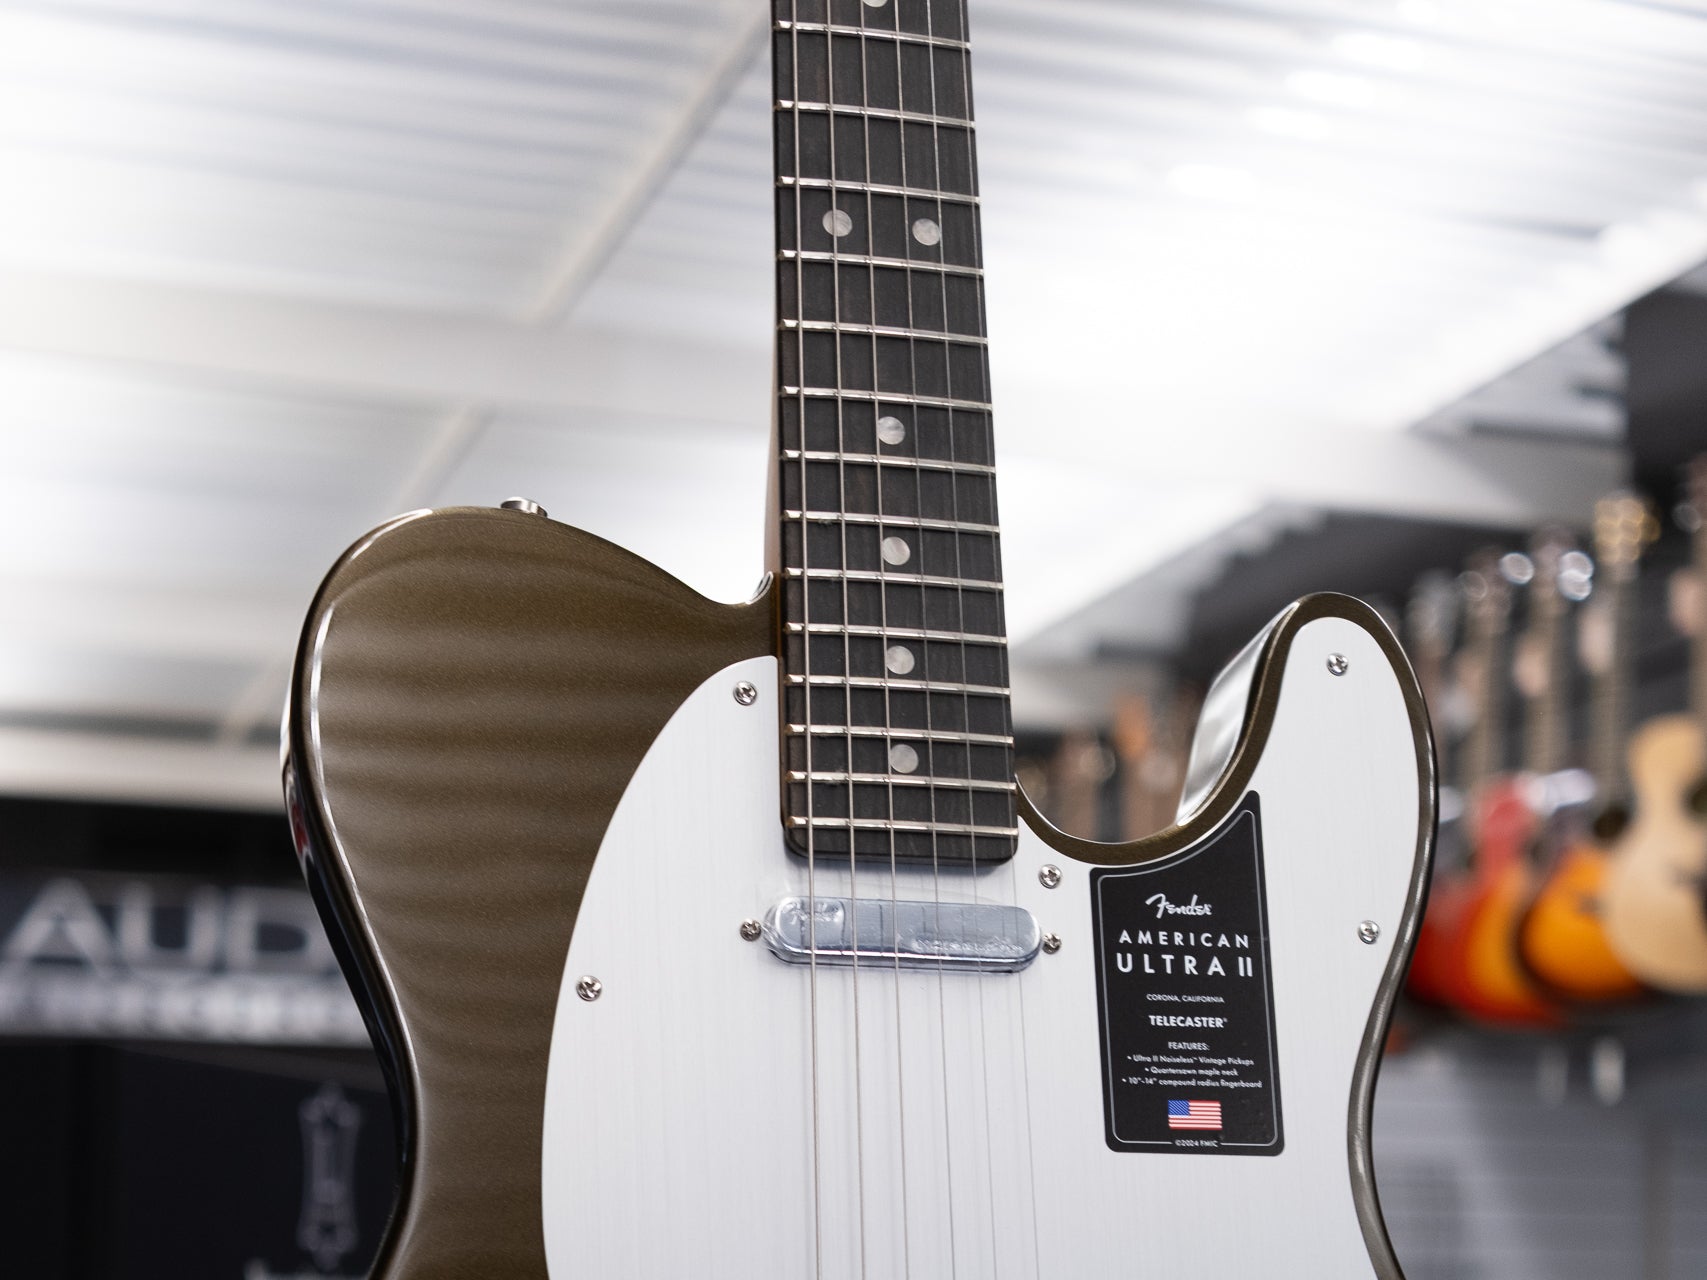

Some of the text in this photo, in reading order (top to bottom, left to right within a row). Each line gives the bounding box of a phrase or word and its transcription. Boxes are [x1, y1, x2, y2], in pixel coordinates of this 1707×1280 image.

[3, 878, 345, 972] AUD
[1119, 929, 1249, 948] AMERICAN
[1116, 952, 1253, 977] ULTRA II
[1146, 994, 1225, 1003] CORONA, CALIFORNIA
[1168, 1041, 1210, 1050] FEATURES:
[1132, 1055, 1152, 1063] Ultra
[1198, 1057, 1226, 1066] Vintage
[1227, 1057, 1254, 1067] Pickups
